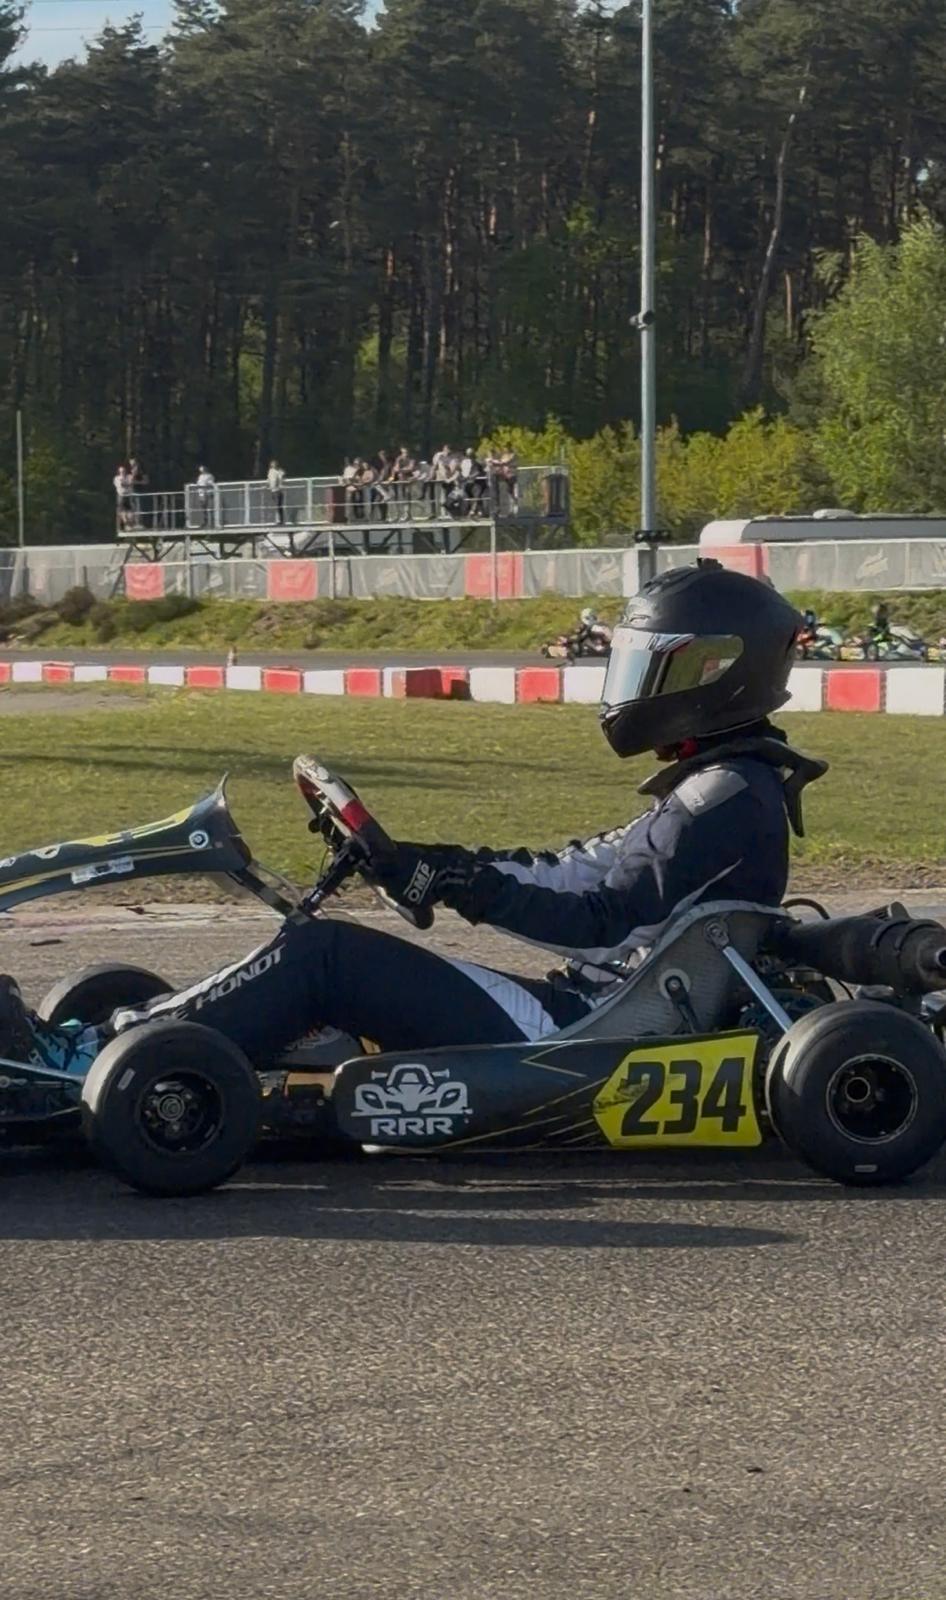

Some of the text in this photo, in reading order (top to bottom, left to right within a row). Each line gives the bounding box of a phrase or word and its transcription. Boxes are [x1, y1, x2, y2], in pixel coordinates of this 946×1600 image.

[407, 862, 431, 902] OMP
[621, 1056, 747, 1136] 234
[370, 1117, 453, 1136] RRR
